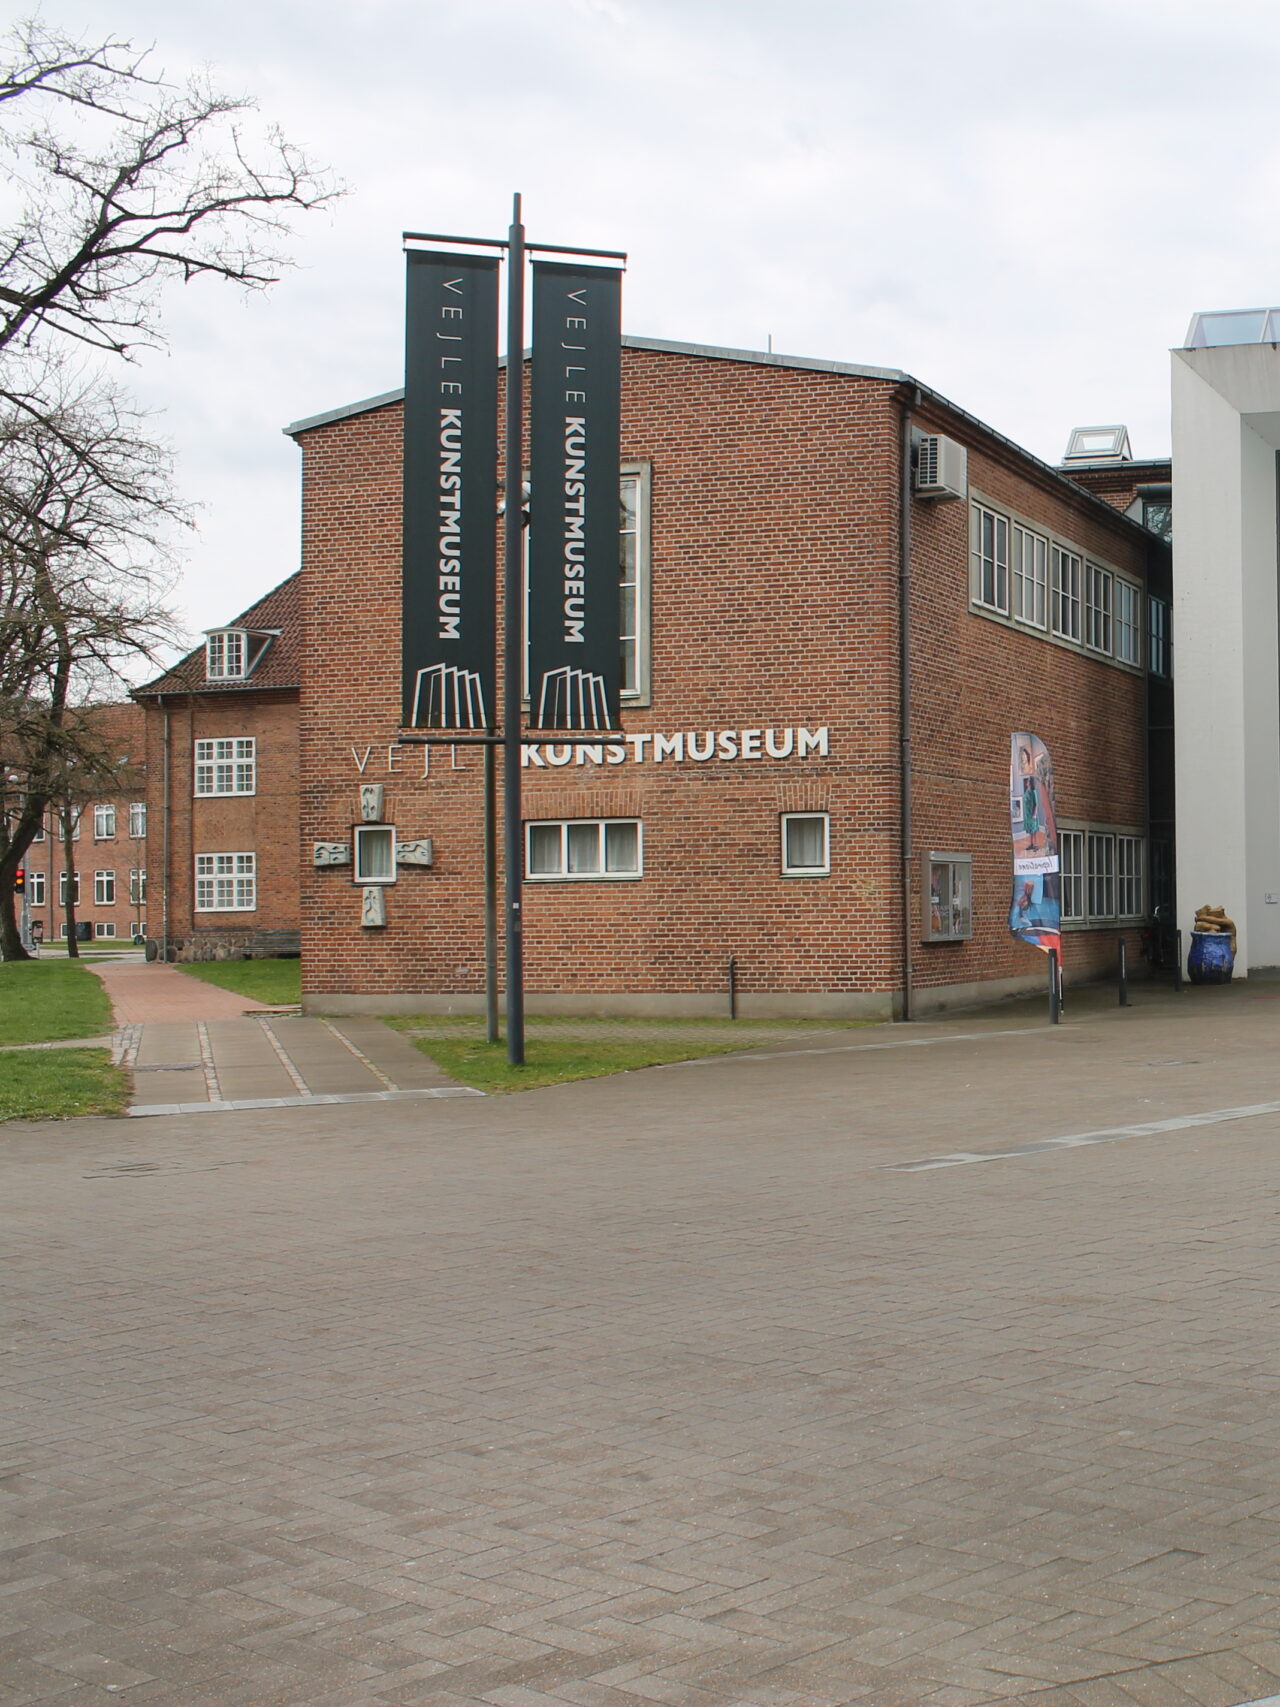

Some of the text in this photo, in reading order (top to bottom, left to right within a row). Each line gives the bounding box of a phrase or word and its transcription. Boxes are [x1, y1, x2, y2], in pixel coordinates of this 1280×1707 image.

[436, 278, 463, 640] VEJLE KUNSTMUSEUM
[561, 289, 587, 643] VEJLE KUNSTMUSEUM
[351, 726, 829, 779] VEJL KUNSTMUSEUM
